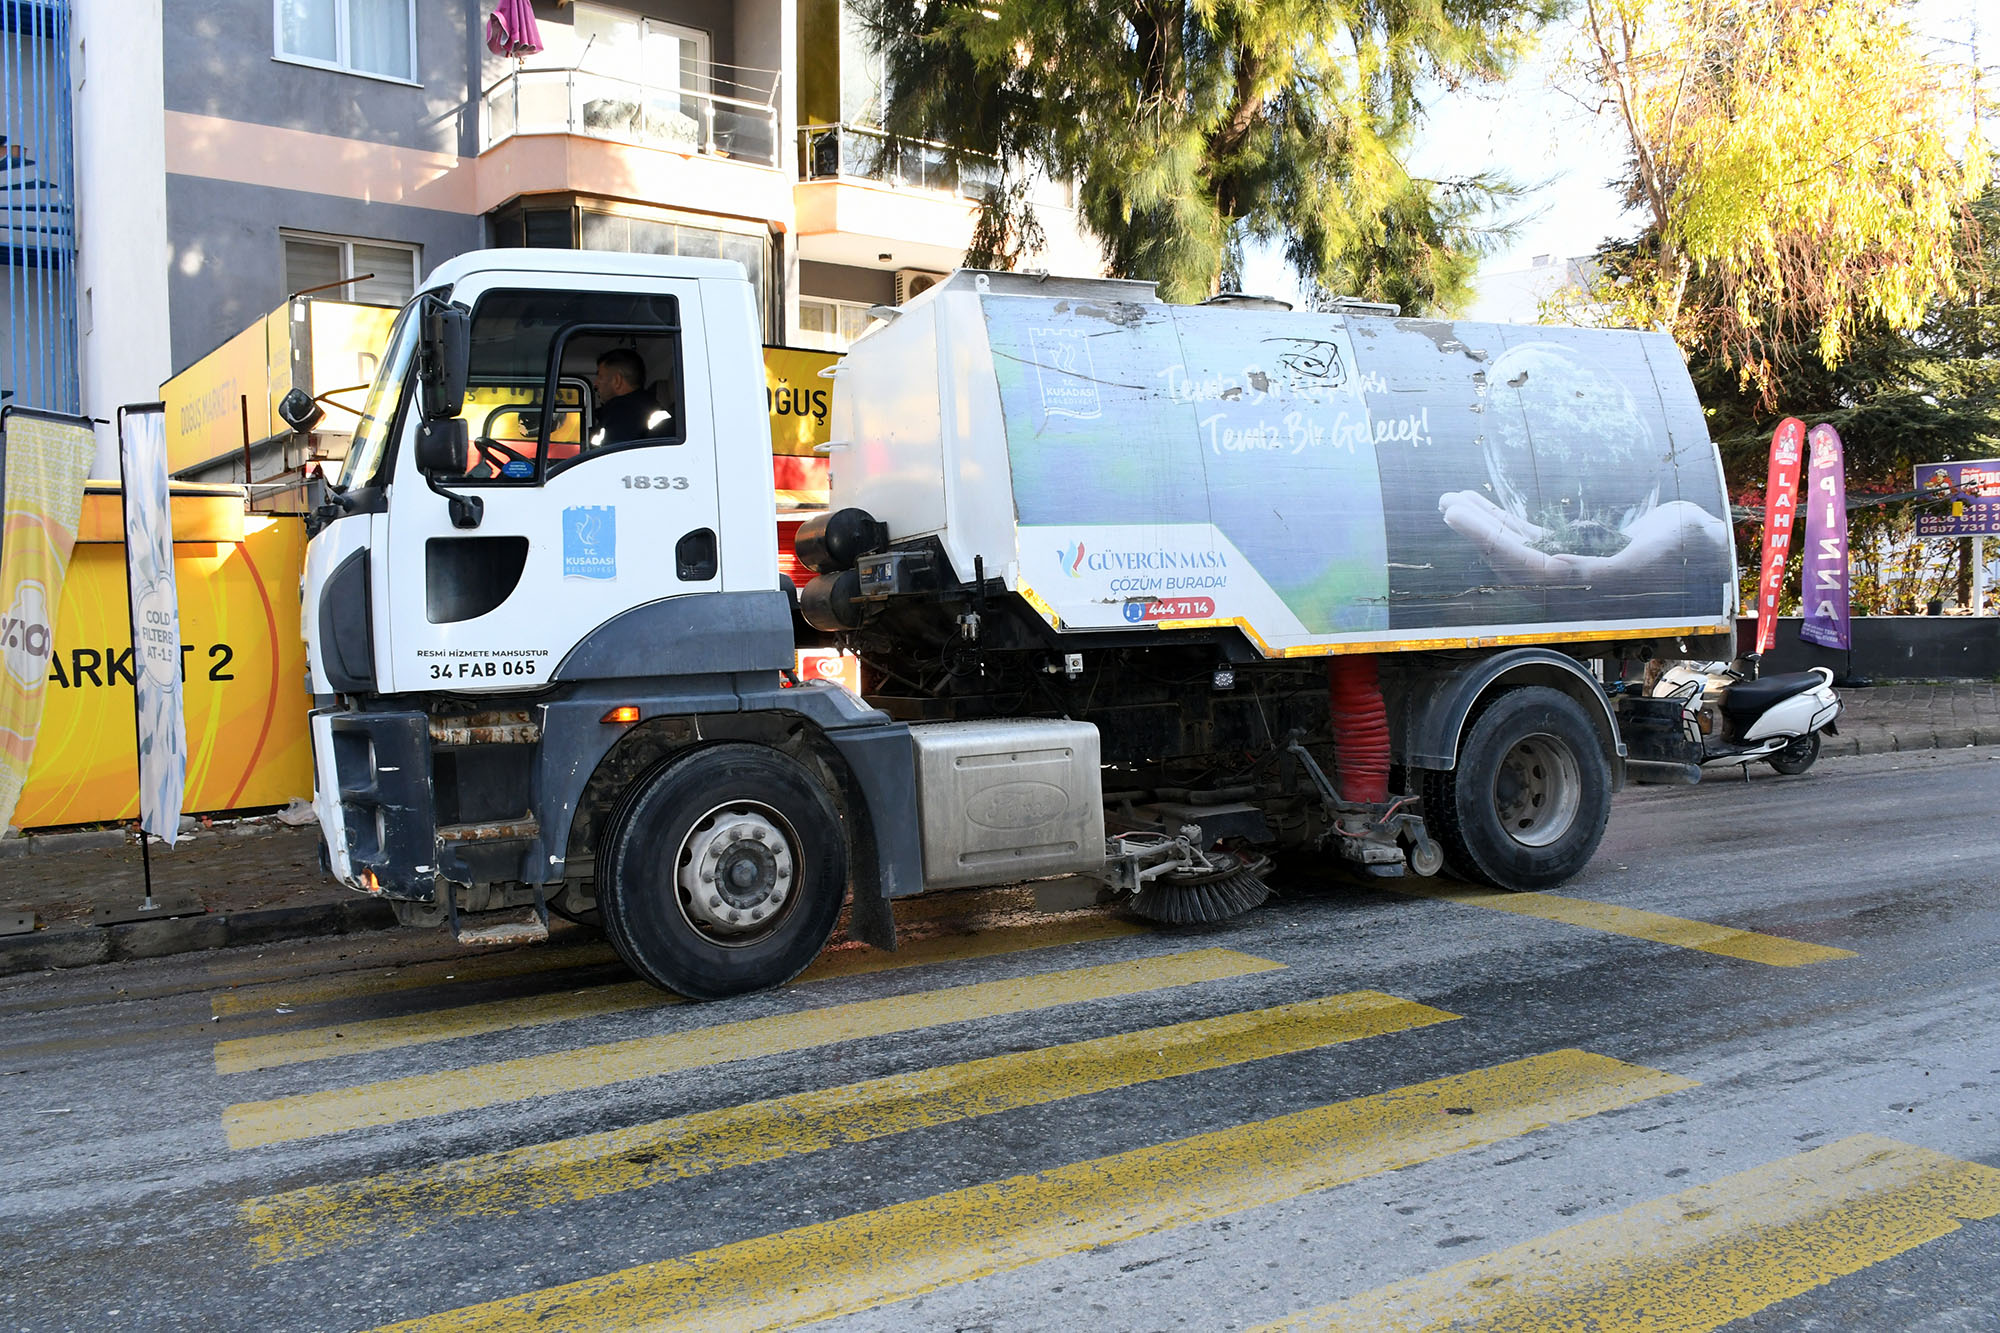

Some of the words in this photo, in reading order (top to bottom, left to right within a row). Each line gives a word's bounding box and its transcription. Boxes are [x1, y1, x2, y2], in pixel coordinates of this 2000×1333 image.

[1200, 412, 1284, 456] Temiz
[1283, 411, 1325, 455] Bir
[1331, 407, 1432, 454] Gelecek!
[621, 475, 690, 490] 1833
[1088, 548, 1177, 571] GÜVERCİN
[1180, 551, 1227, 568] MASA
[1110, 575, 1162, 595] ÇÖZÜM
[1166, 576, 1227, 589] BURADA!
[146, 610, 171, 626] COLD
[1149, 603, 1175, 616] 444
[1178, 603, 1191, 614] 71
[1194, 602, 1208, 613] 14
[417, 649, 446, 657] RESMİ
[449, 649, 489, 657] HİZMETE
[492, 649, 549, 657] MAHSUSTUR
[208, 644, 235, 682] 2
[430, 664, 453, 679] 34
[459, 662, 496, 678] FAB
[503, 660, 535, 676] 065
